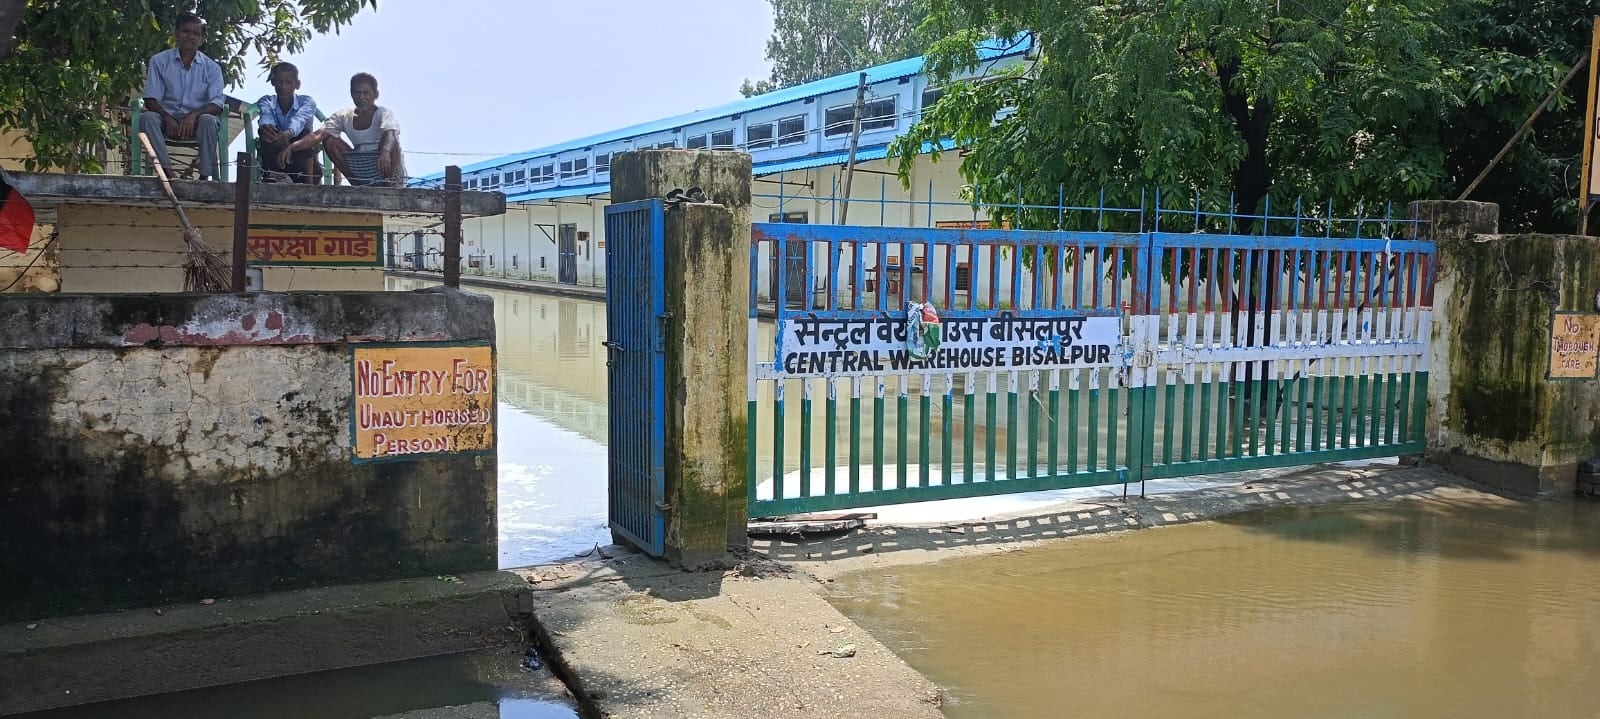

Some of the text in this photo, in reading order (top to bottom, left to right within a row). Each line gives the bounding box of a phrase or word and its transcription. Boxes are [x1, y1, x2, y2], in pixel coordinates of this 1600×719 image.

[247, 236, 318, 260] सुरक्षा
[990, 311, 1087, 347] बीसलपुर
[785, 350, 883, 374] CENTRAL
[1012, 344, 1111, 367] BISALPUR
[452, 358, 489, 395] FOR
[361, 403, 490, 431] UNAUTHORISED
[373, 433, 450, 455] PERSON
